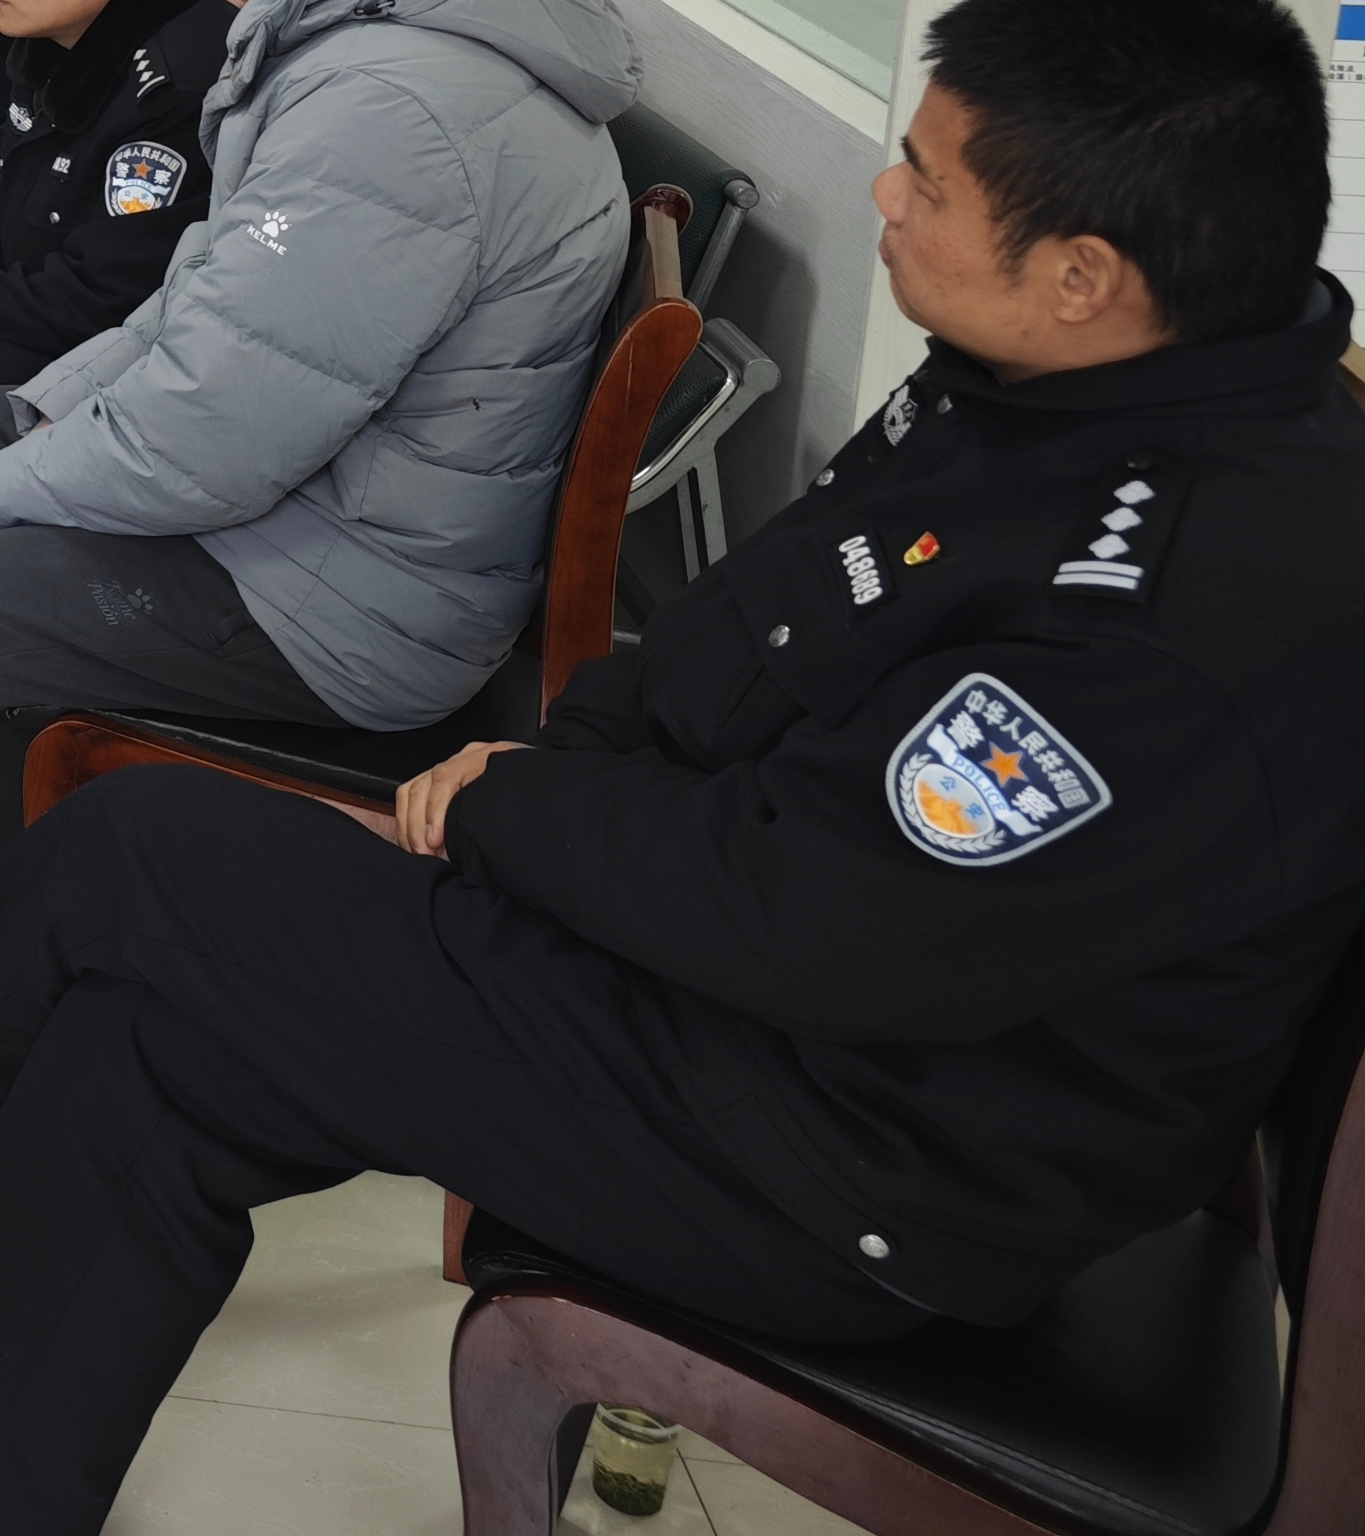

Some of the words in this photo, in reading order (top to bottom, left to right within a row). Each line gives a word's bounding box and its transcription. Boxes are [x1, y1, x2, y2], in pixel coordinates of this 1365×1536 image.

[246, 224, 288, 256] KELME
[964, 690, 1092, 809] 中华人民共和国
[952, 754, 1007, 813] POLICE
